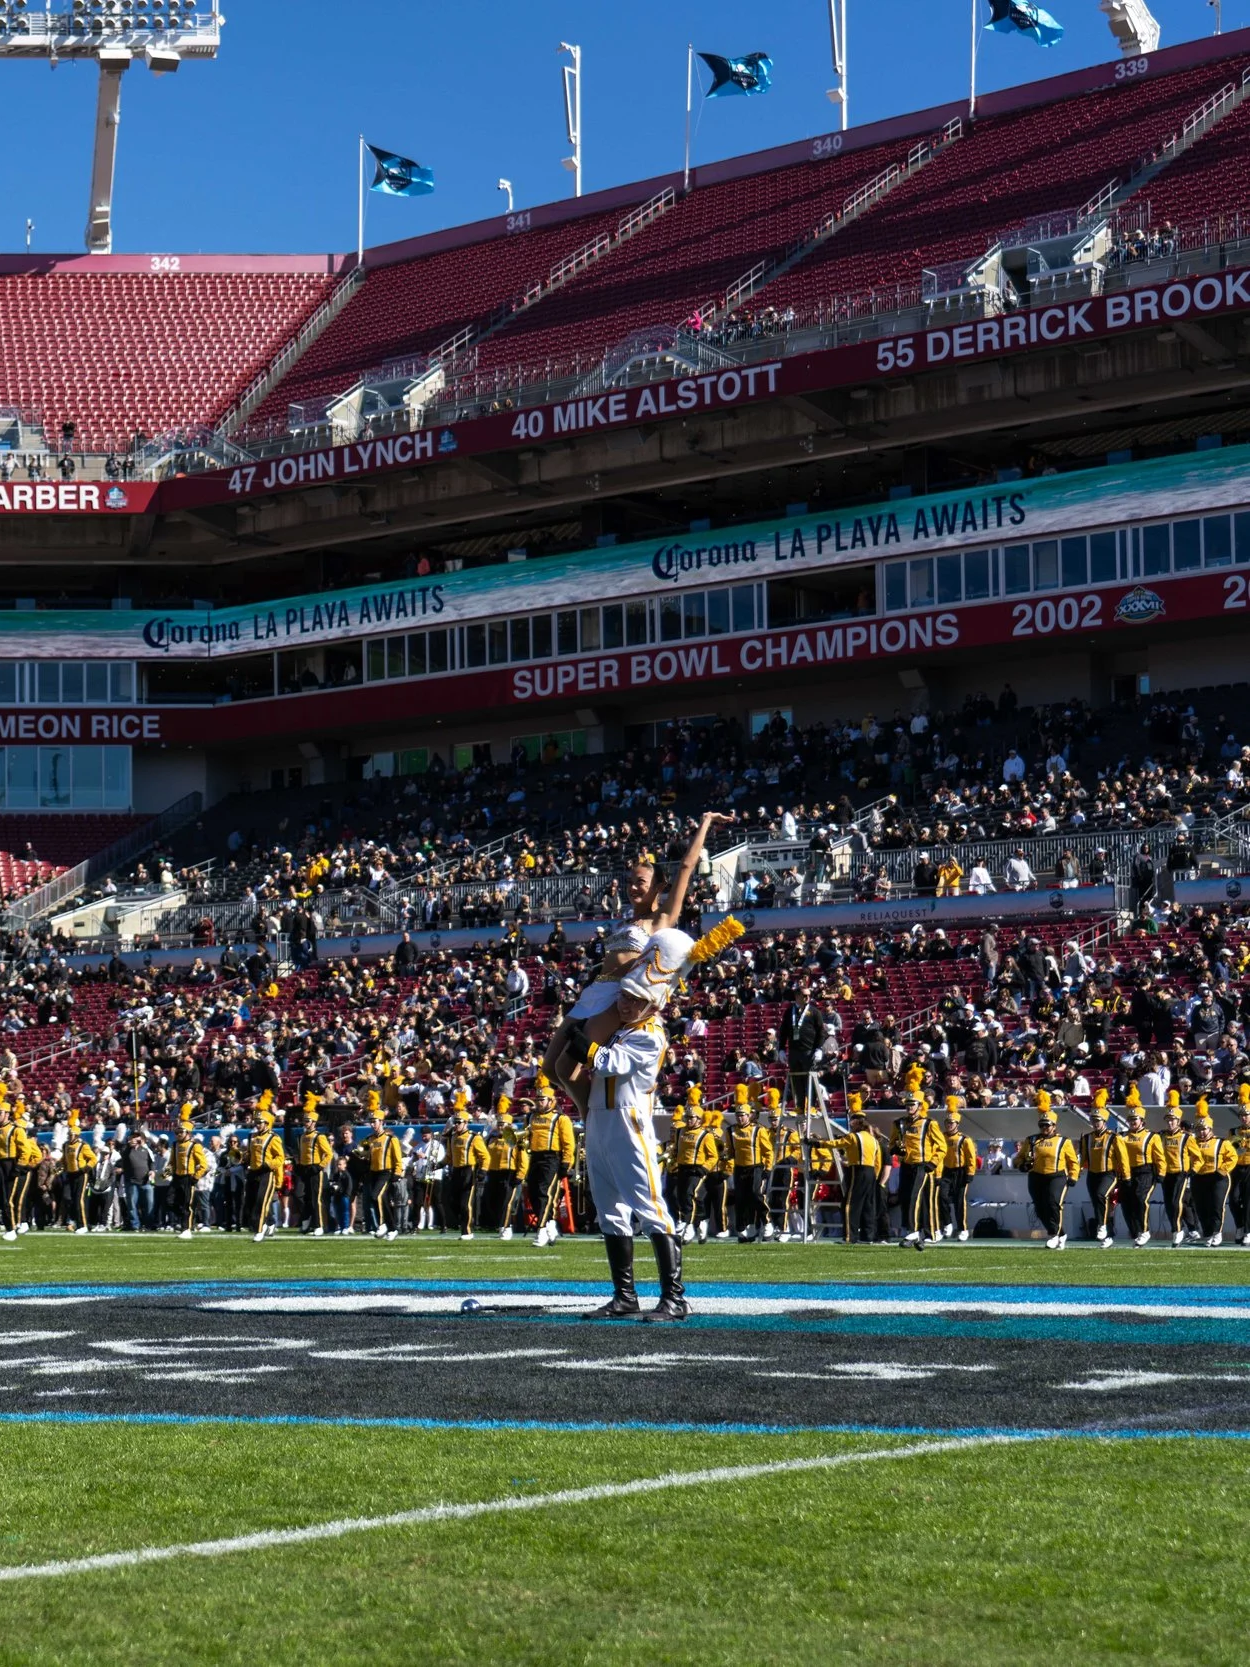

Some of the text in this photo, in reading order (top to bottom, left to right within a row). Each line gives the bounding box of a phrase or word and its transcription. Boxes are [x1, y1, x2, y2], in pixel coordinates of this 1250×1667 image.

[1114, 57, 1148, 79] 339
[813, 135, 843, 155] 340
[506, 212, 531, 230] 341
[150, 256, 180, 271] 342
[876, 338, 915, 371] 55
[926, 301, 1094, 363] DERRICK
[511, 362, 783, 440] 40 MIKE ALSTOTT
[228, 432, 434, 494] 47 JOHN LYNCH
[651, 491, 1026, 583] Corona LA PLAYA AWAITS
[142, 585, 445, 652] Corona LA PLAYA AWAITS
[513, 594, 1103, 700] SUPER BOWL CHAMPIONS 2002
[91, 715, 160, 738] RICE
[860, 908, 927, 921] RELIAQUEST
